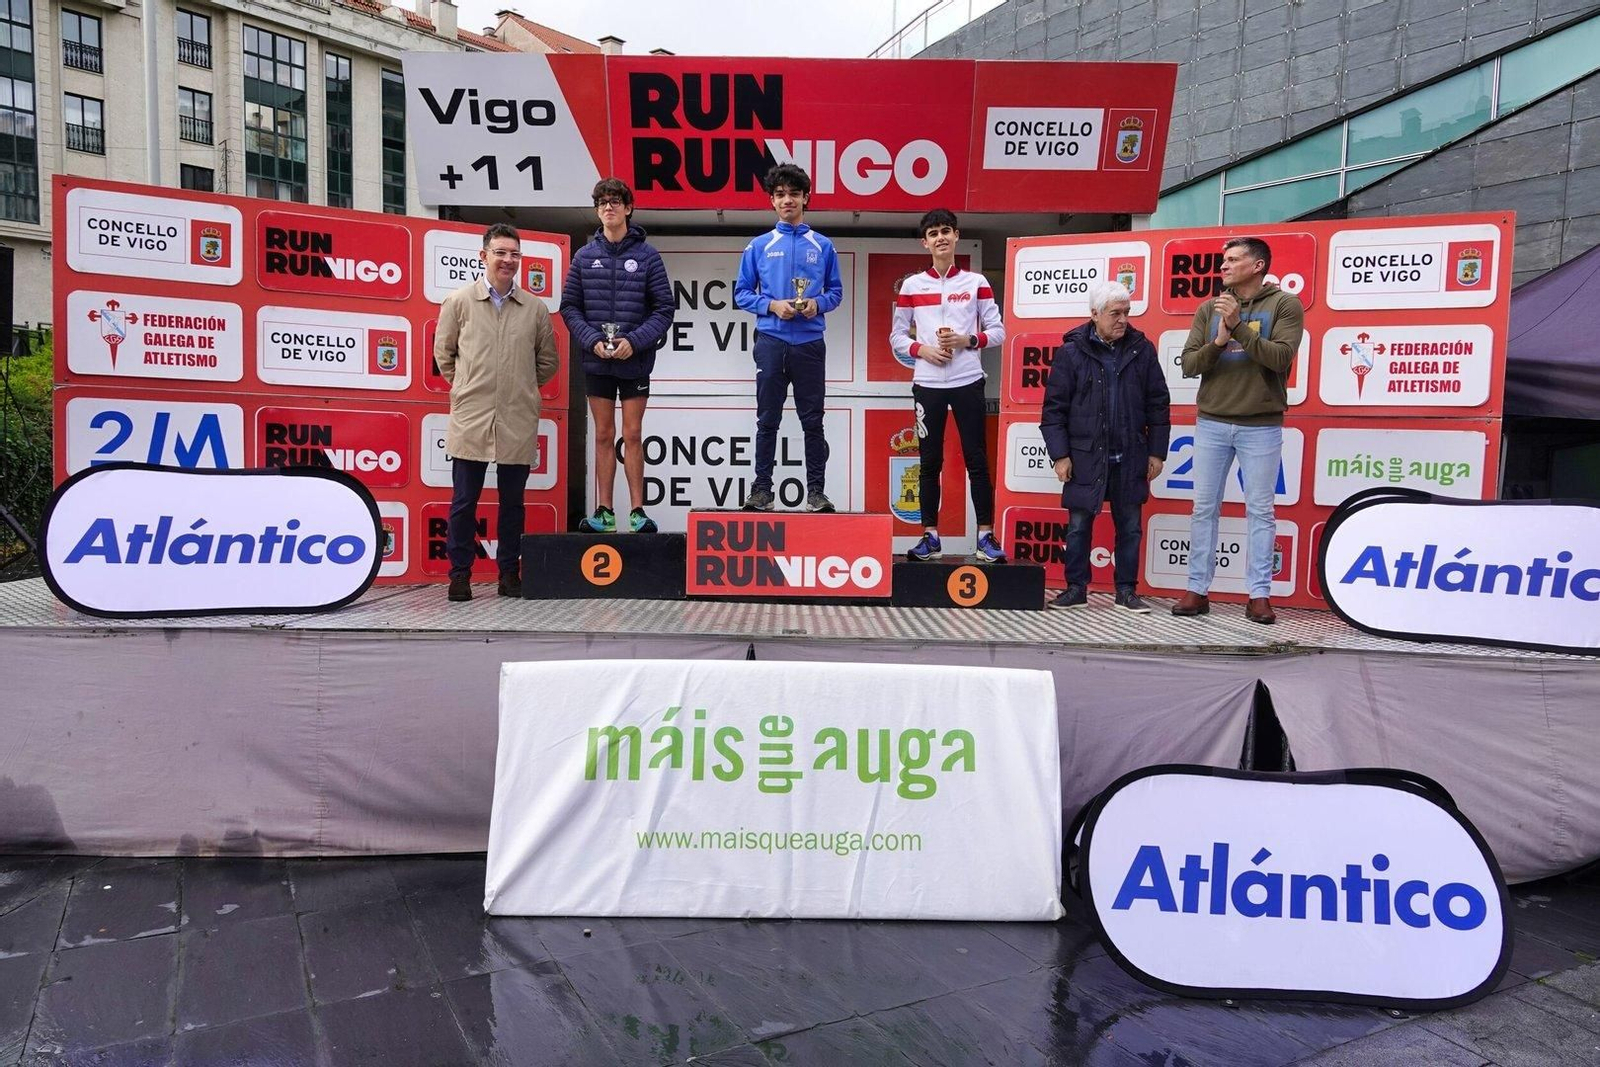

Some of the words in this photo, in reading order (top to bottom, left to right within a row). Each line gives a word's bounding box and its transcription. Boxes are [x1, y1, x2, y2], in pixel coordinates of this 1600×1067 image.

[629, 72, 783, 131] RUN
[418, 87, 556, 134] Vigo
[994, 121, 1092, 136] CONCELLO
[1004, 141, 1028, 155] DE
[1035, 141, 1079, 156] VIGO
[440, 156, 543, 191] +11
[87, 217, 178, 238] CONCELLO
[98, 233, 120, 247] DE
[127, 235, 167, 252] VIGO
[266, 227, 332, 254] RUN
[441, 256, 486, 269] CONCE
[1342, 253, 1433, 269] CONCELLO
[450, 270, 466, 280] DE
[1025, 267, 1097, 282] CONCELLO
[1352, 271, 1374, 284] DE
[1380, 270, 1421, 283] VIGO
[1033, 284, 1050, 295] DE
[1054, 282, 1088, 294] VIGO
[143, 314, 226, 331] FEDERACIÓN
[143, 333, 195, 348] GALEGA
[198, 336, 215, 349] DE
[271, 332, 356, 349] CONCELLO
[1390, 340, 1473, 356] FEDERACIÓN
[143, 351, 218, 367] ATLETISMO
[281, 346, 302, 360] DE
[308, 348, 347, 363] VIGO
[1023, 346, 1061, 367] RU
[1389, 361, 1439, 374] GALEGA
[1443, 361, 1460, 374] DE
[1387, 380, 1461, 393] ATLETISMO
[265, 423, 332, 446] RUN
[1028, 459, 1044, 469] DE
[1327, 454, 1384, 478] máis
[1389, 457, 1405, 483] que
[1409, 461, 1470, 486] auga
[643, 477, 691, 506] DE
[707, 477, 804, 507] VIO
[696, 520, 785, 552] RUN
[1015, 520, 1069, 542] RUN
[63, 516, 366, 565] Atlántico
[1160, 538, 1240, 555] CONLO
[593, 552, 610, 578] 2
[1168, 553, 1188, 565] DE
[958, 573, 977, 599] 3
[584, 707, 745, 782] máis
[758, 714, 803, 794] que
[813, 726, 976, 800] auga
[636, 827, 922, 855] www.maisqueauga.com
[1111, 842, 1487, 931] Atlántico
